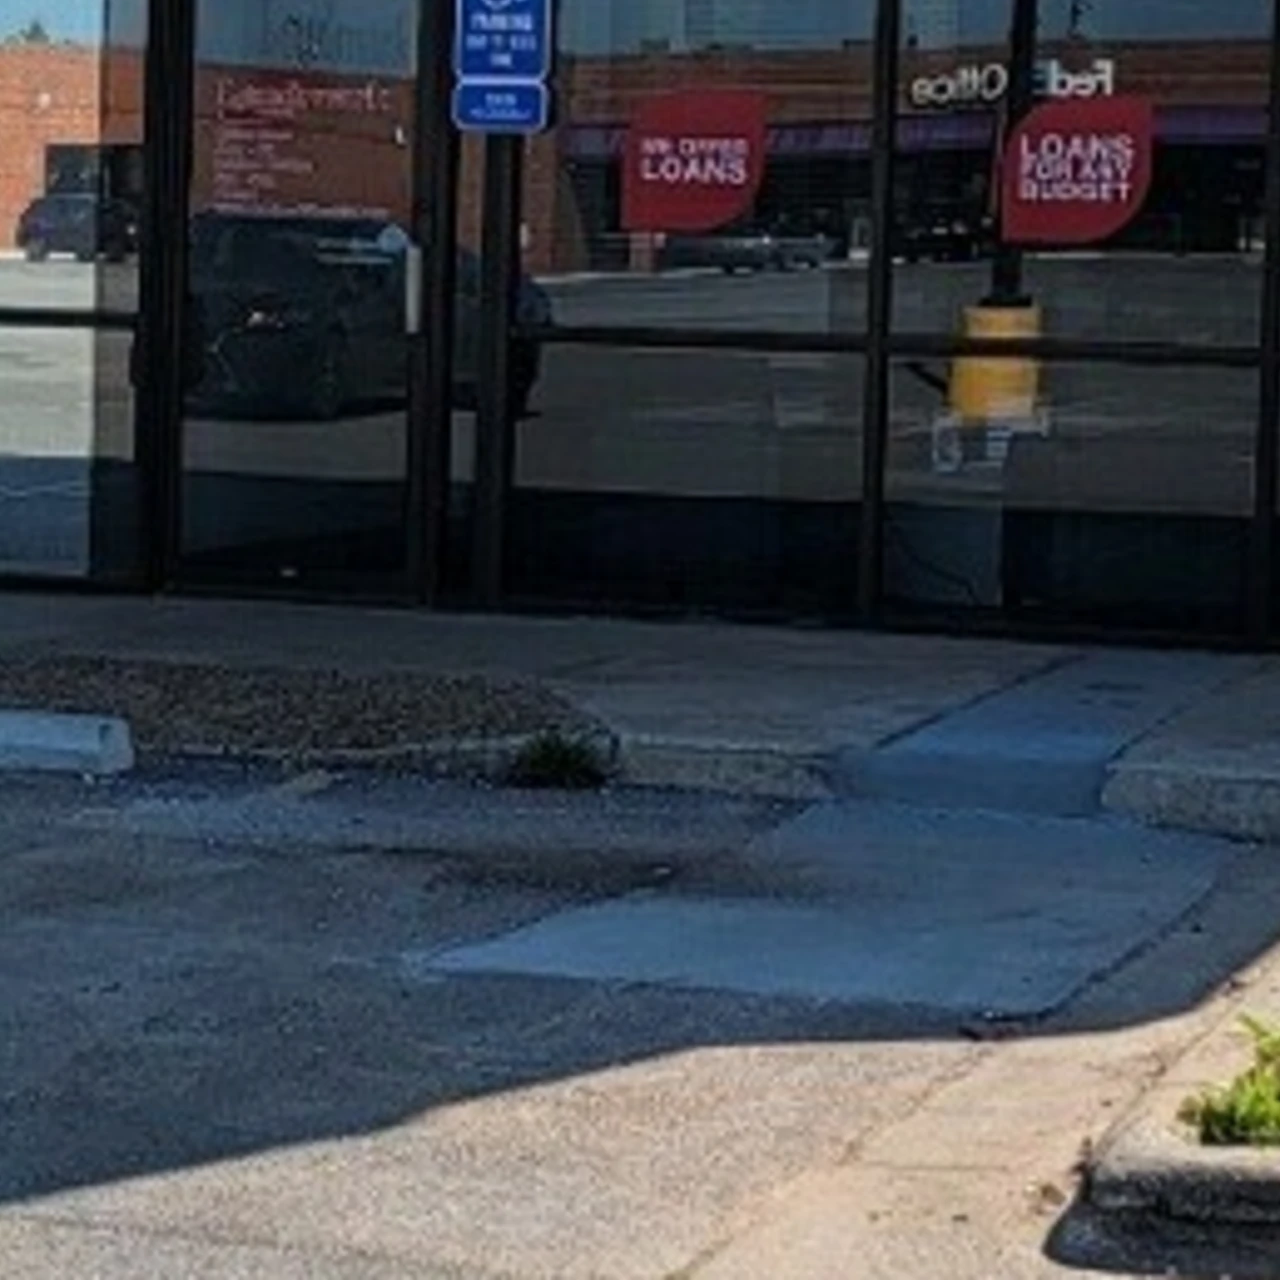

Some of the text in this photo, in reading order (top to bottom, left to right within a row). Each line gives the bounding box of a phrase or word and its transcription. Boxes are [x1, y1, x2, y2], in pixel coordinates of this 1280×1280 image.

[1021, 132, 1134, 162] LOANS
[639, 156, 748, 186] LOANS
[1019, 181, 1133, 201] BUDGET
